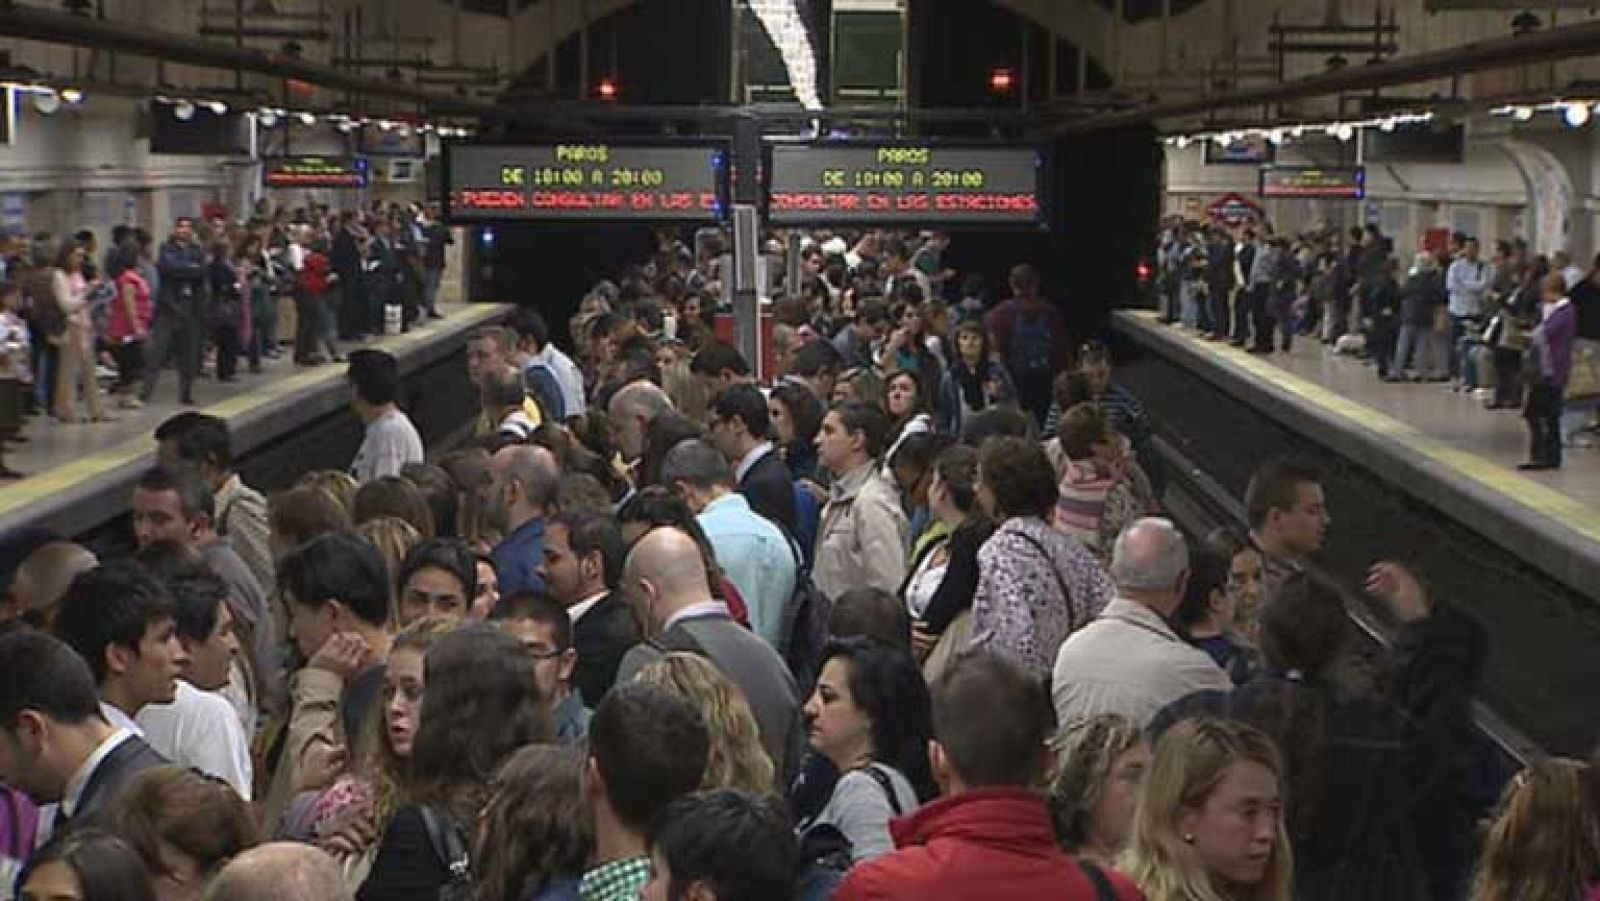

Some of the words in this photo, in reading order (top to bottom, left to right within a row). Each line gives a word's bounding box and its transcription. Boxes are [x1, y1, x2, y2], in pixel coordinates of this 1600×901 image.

[557, 145, 608, 162] PAROS
[877, 147, 929, 164] PAROS
[502, 168, 523, 184] DE
[612, 168, 664, 185] 20:00
[823, 170, 845, 187] DE
[911, 170, 924, 187] A
[931, 170, 984, 187] 20:00
[533, 192, 624, 209] CONSULTAR
[631, 193, 652, 209] EN
